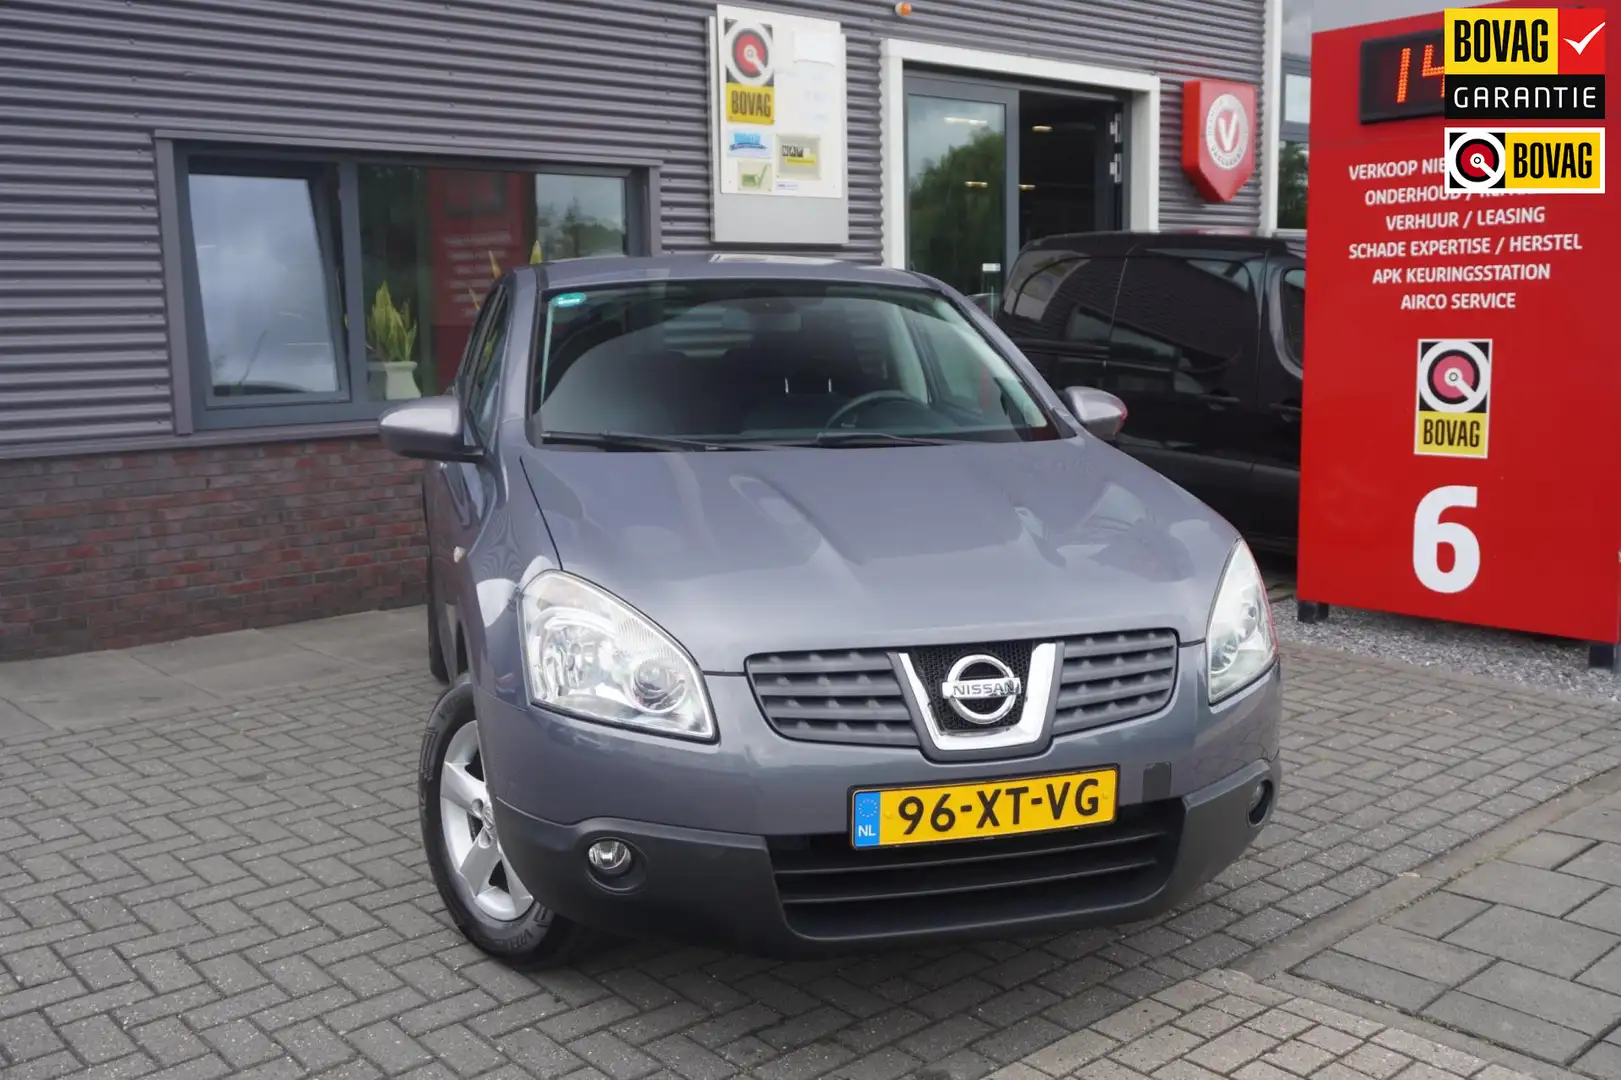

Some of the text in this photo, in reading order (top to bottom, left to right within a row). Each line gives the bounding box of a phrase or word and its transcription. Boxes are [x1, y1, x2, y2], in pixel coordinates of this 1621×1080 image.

[731, 90, 771, 118] BOVAG
[1349, 157, 1445, 181] VERKOOP NIE
[1386, 206, 1546, 231] VERHUUR / LEASING
[1348, 233, 1583, 260] SCHADE EXPERTISE / HERSTEL
[1372, 263, 1551, 285] APK KEURINGSSTATION
[1400, 291, 1517, 311] AIRCO SERVICE
[1423, 418, 1481, 448] BOVAG
[1412, 484, 1482, 594] 6
[952, 679, 1018, 698] NISSAN
[897, 778, 1100, 836] 96-XT-VG
[857, 824, 876, 838] NL
